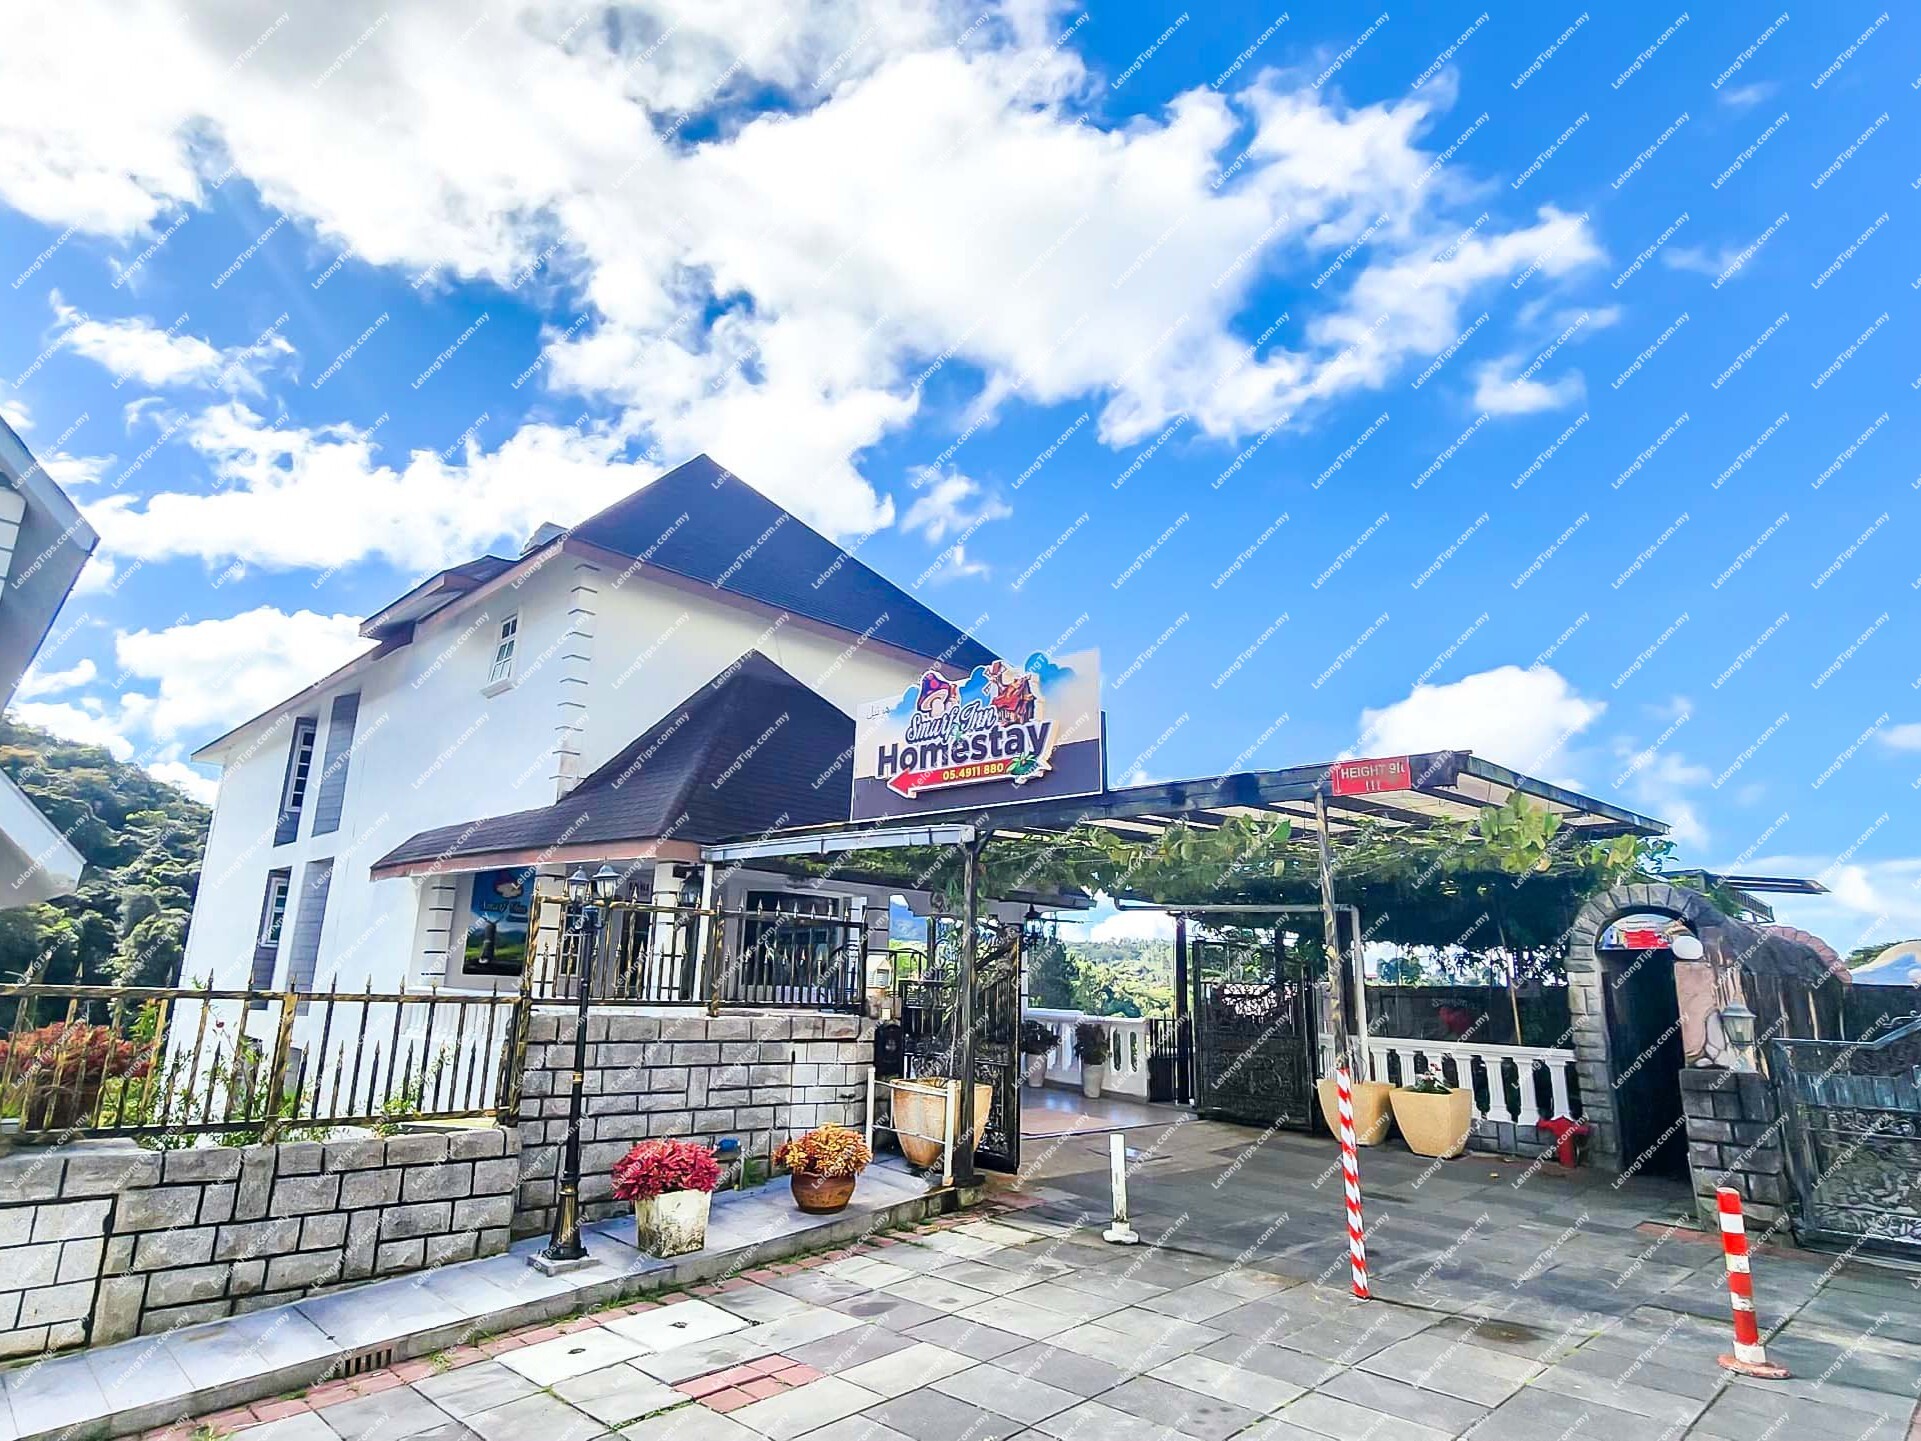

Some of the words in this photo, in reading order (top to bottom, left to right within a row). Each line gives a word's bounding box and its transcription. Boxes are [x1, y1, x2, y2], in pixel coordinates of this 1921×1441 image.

[907, 706, 957, 742] Smurf
[960, 701, 996, 729] Inn
[878, 722, 1051, 776] Homestay
[943, 766, 981, 780] 05.4911
[983, 763, 1004, 774] 880
[1341, 764, 1386, 779] HEIGHT
